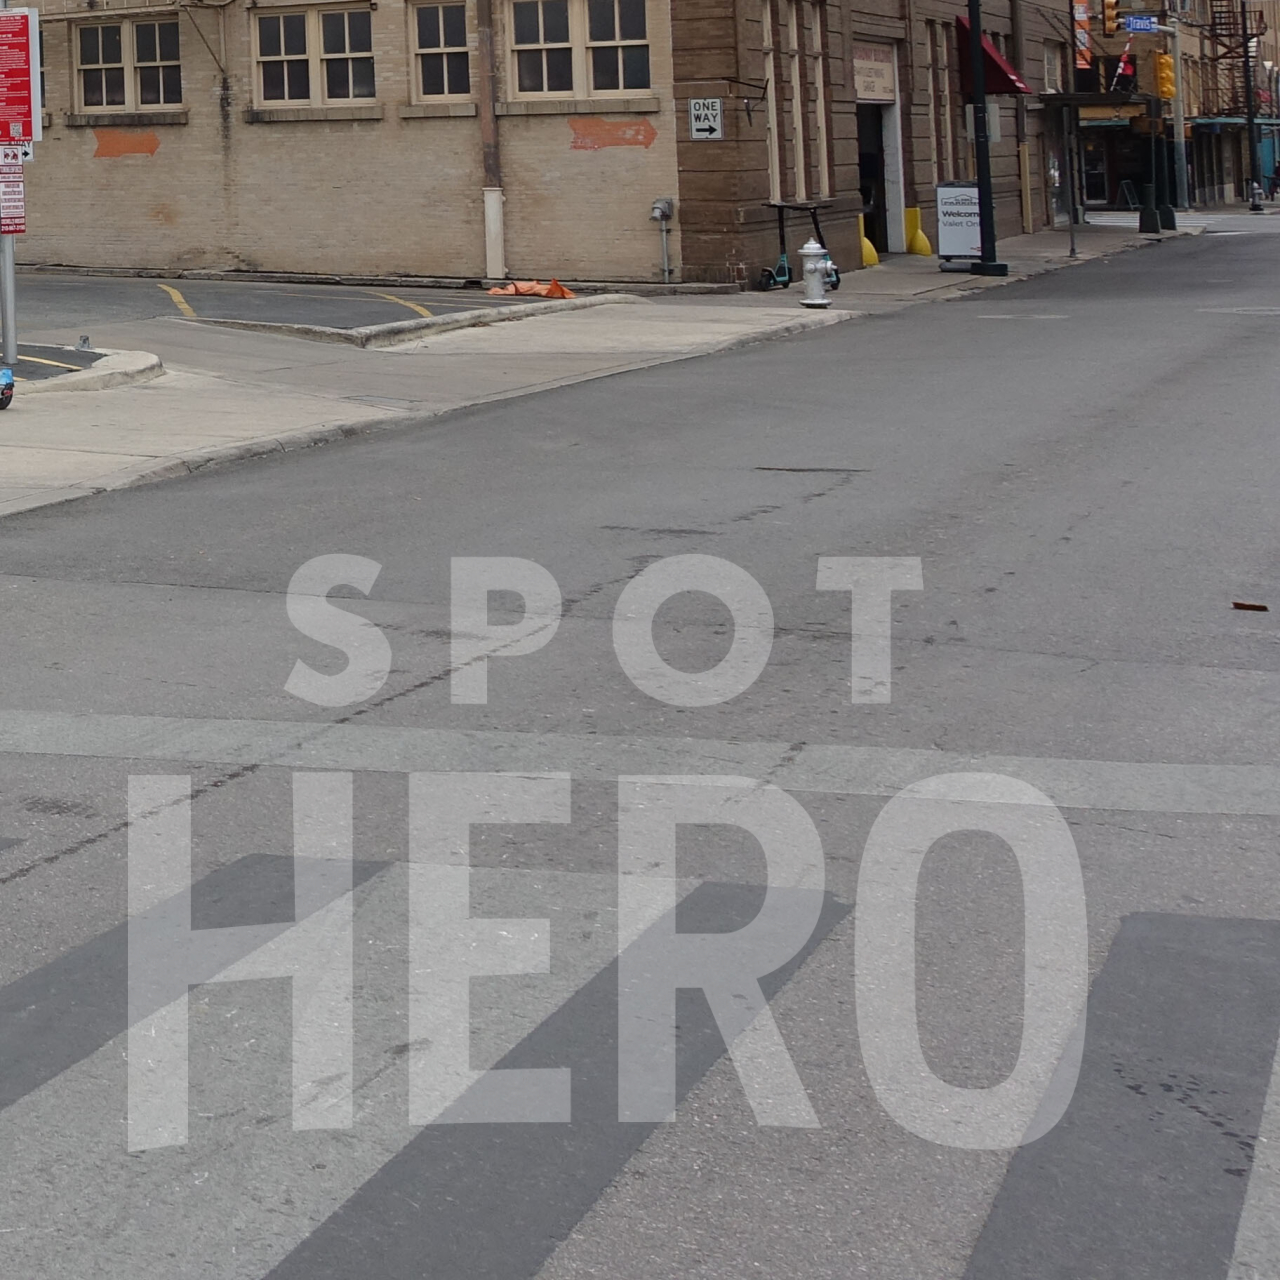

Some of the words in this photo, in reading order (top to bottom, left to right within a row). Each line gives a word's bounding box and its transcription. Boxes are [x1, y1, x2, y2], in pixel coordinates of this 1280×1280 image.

[1130, 17, 1151, 29] Travis
[693, 101, 718, 111] ONE
[693, 112, 719, 123] WAY
[942, 210, 979, 218] Welcom
